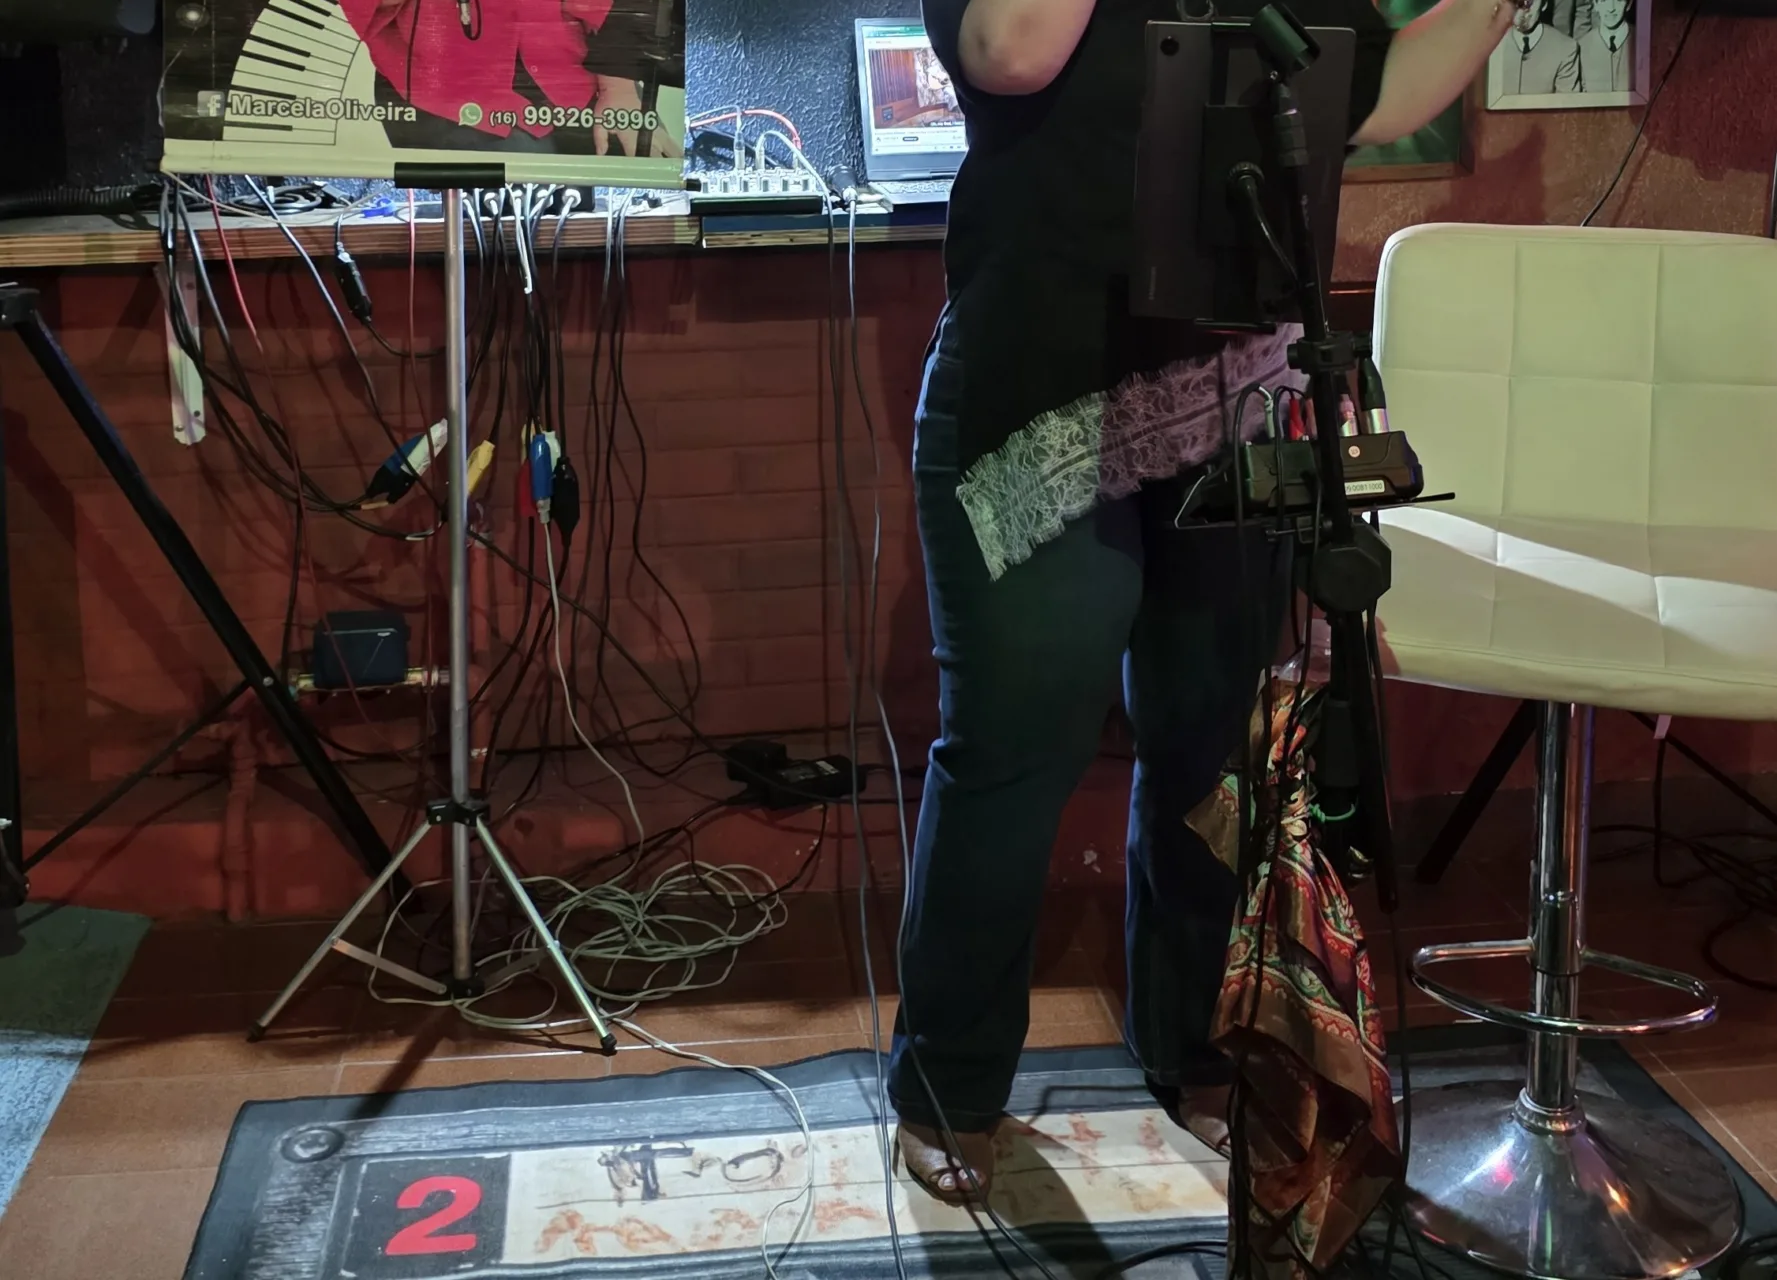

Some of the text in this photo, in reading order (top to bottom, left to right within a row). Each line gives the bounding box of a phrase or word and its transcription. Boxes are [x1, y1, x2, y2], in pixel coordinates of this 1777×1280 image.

[230, 93, 418, 122] MarcelaOliveira
[489, 105, 659, 131] (16) 99326-3996
[384, 1175, 483, 1257] 2
